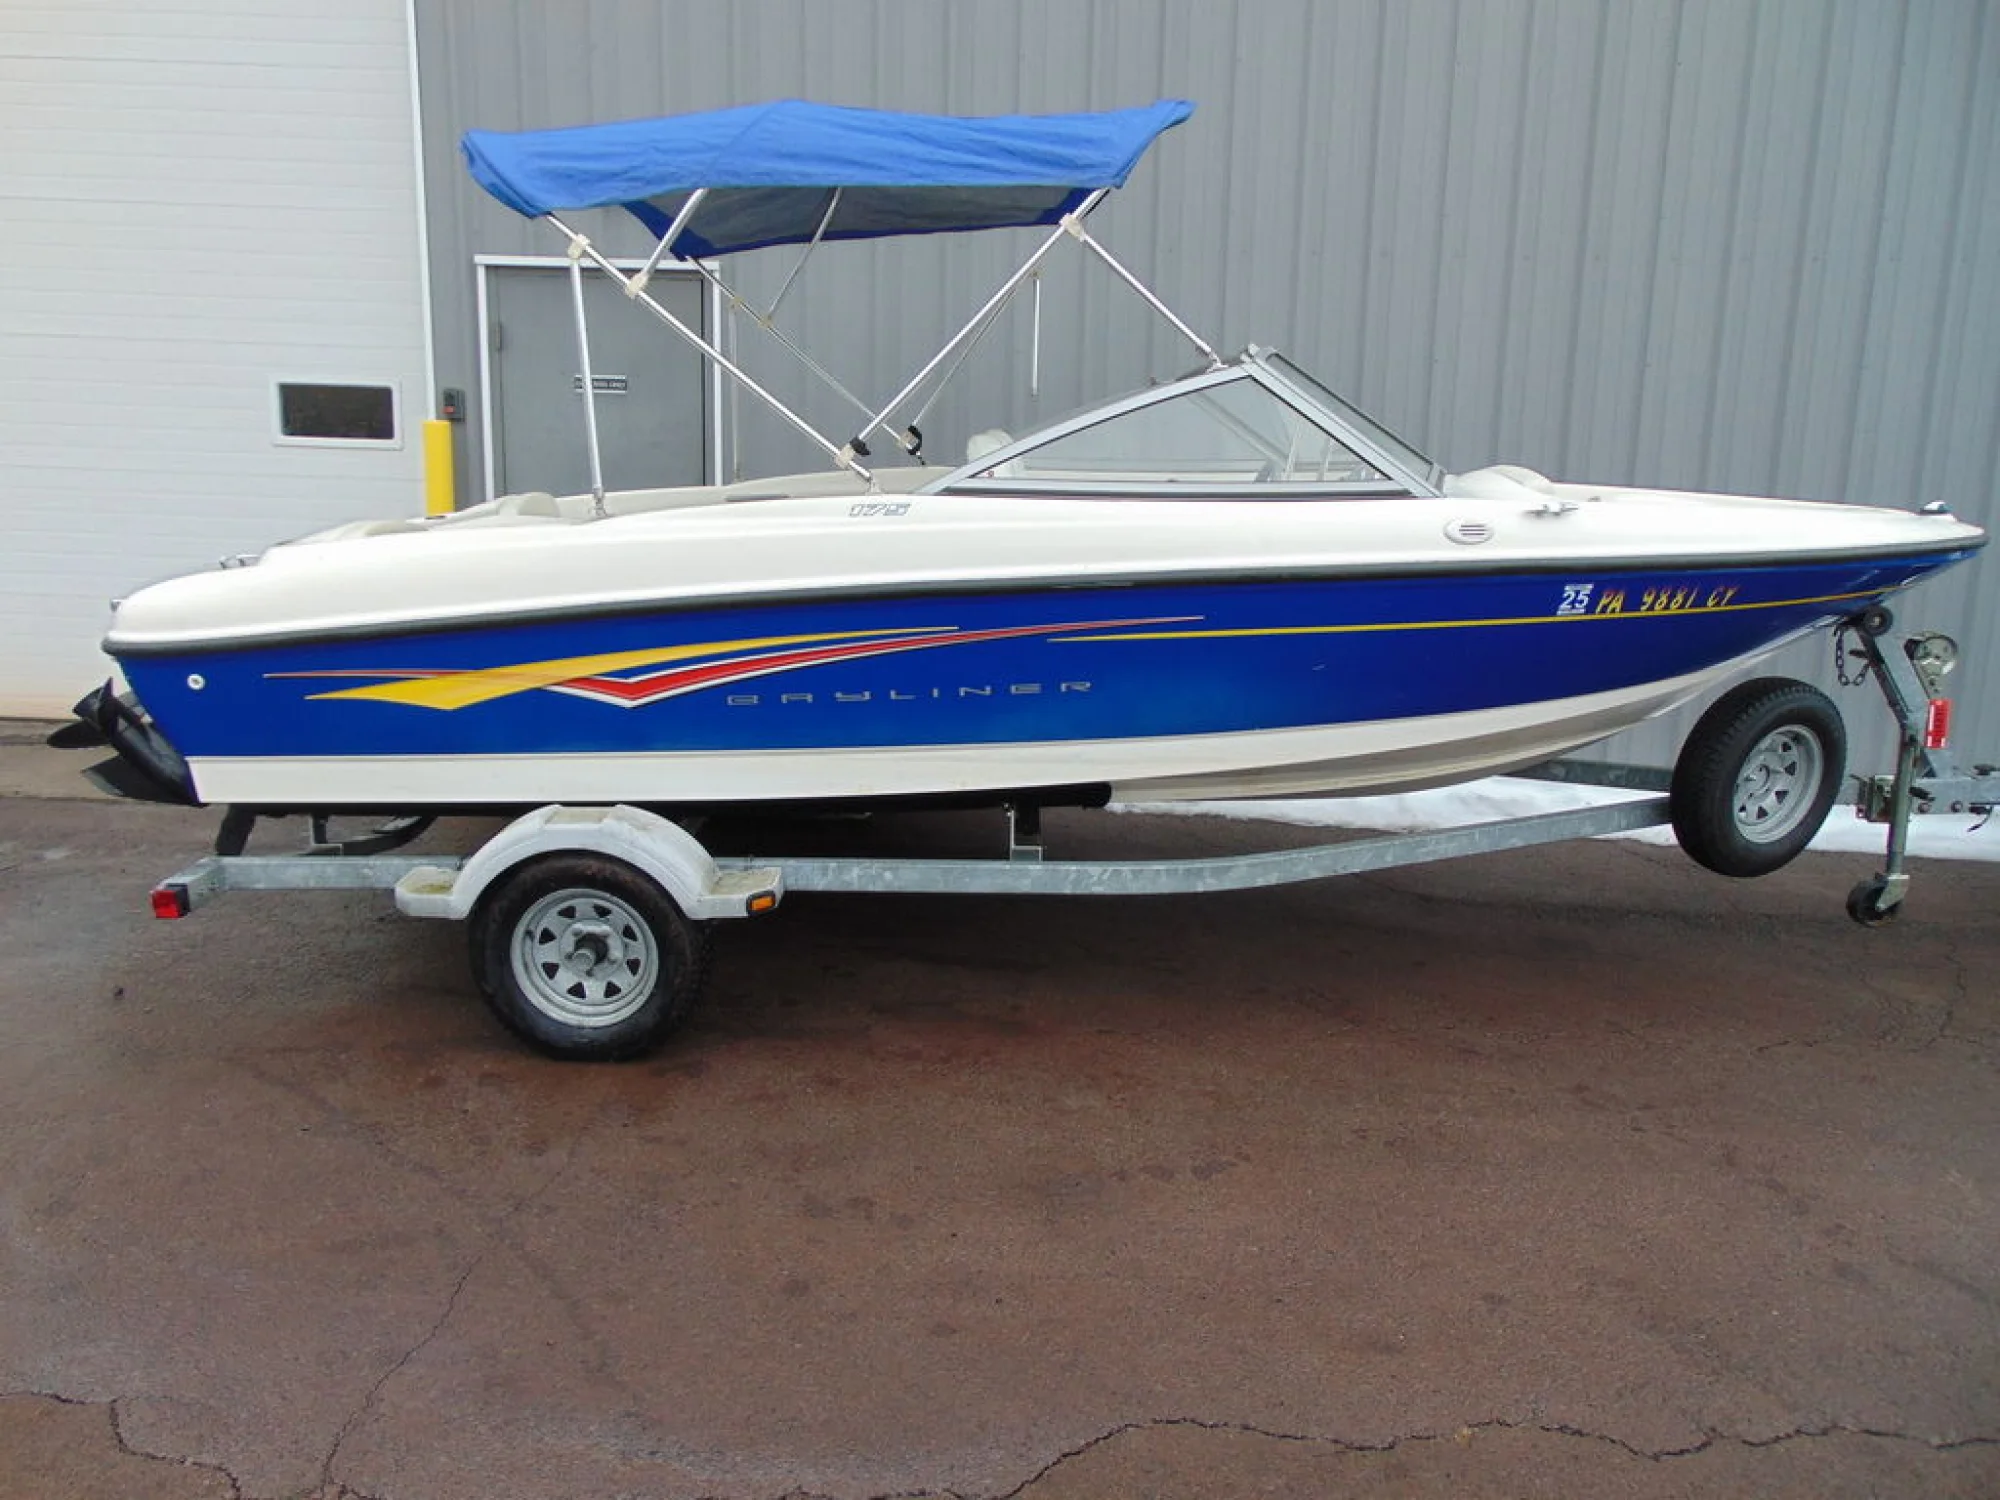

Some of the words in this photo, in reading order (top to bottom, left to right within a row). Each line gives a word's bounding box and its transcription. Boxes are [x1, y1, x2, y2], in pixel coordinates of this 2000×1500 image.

[1559, 590, 1591, 609] 25
[1595, 589, 1625, 614] PA
[726, 680, 1092, 706] BAYLINER
